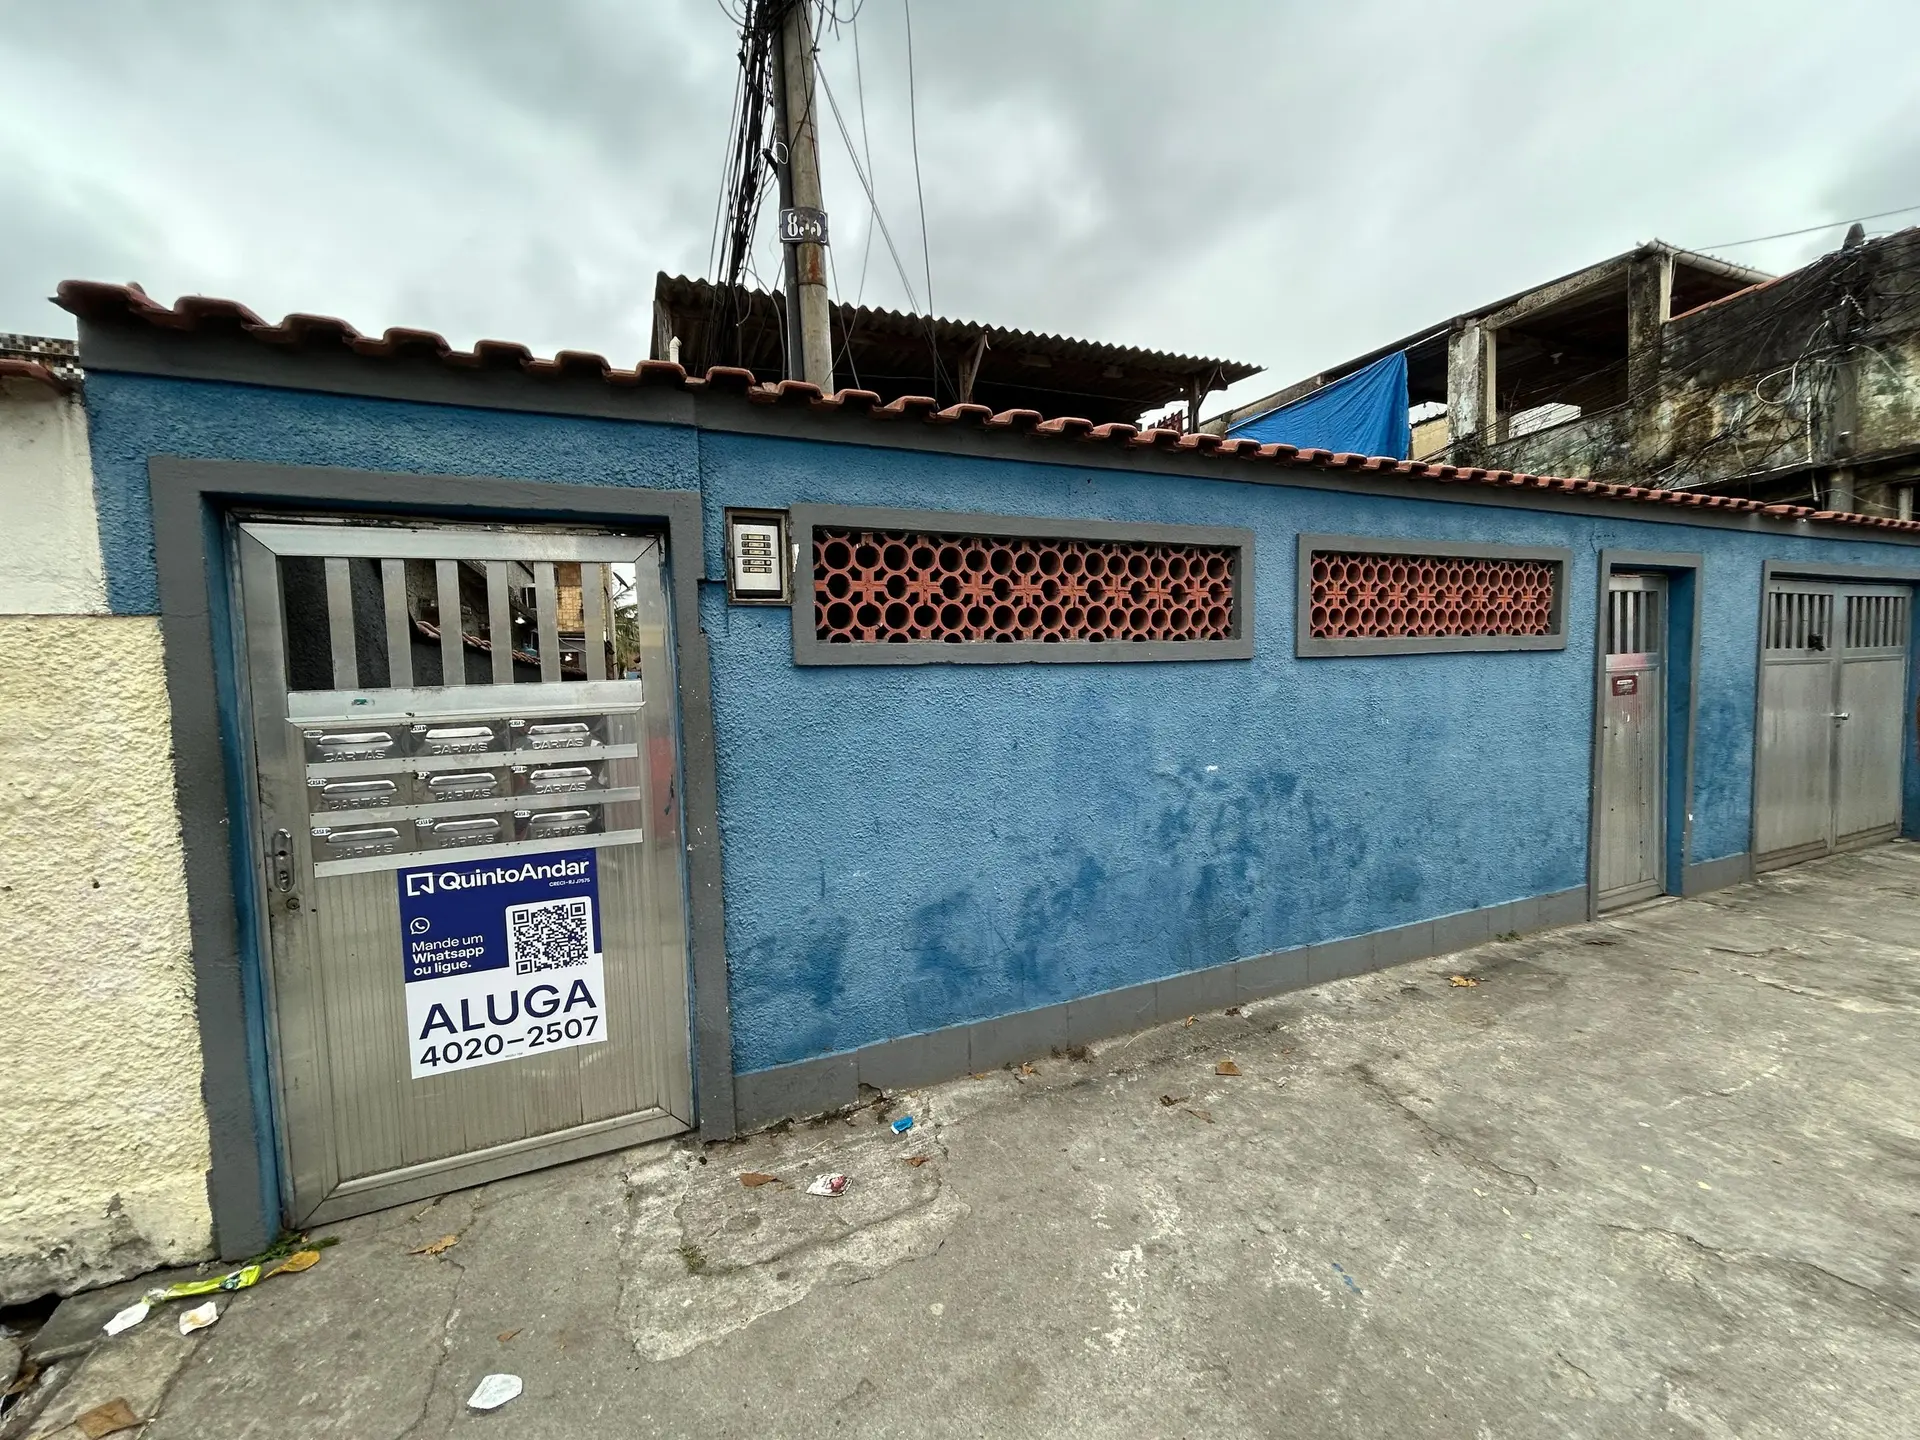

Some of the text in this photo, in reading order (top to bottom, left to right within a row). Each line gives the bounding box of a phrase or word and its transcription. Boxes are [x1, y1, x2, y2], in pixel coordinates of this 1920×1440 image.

[432, 742, 488, 754] CARTAS
[532, 738, 584, 750] CARTAS
[324, 750, 386, 762] CARTAS
[436, 788, 491, 801] CARTAS
[535, 782, 587, 794] CARTAS
[329, 796, 390, 810] CARTAS
[535, 825, 587, 838] CARTAS
[440, 834, 495, 848] CARTAS
[438, 860, 589, 891] QuintoAndar
[412, 934, 484, 952] Mande um
[412, 946, 485, 964] Whatsapp
[413, 960, 472, 976] ou ligue.
[419, 979, 597, 1040] ALUGA
[420, 1015, 599, 1067] 4020-2507
